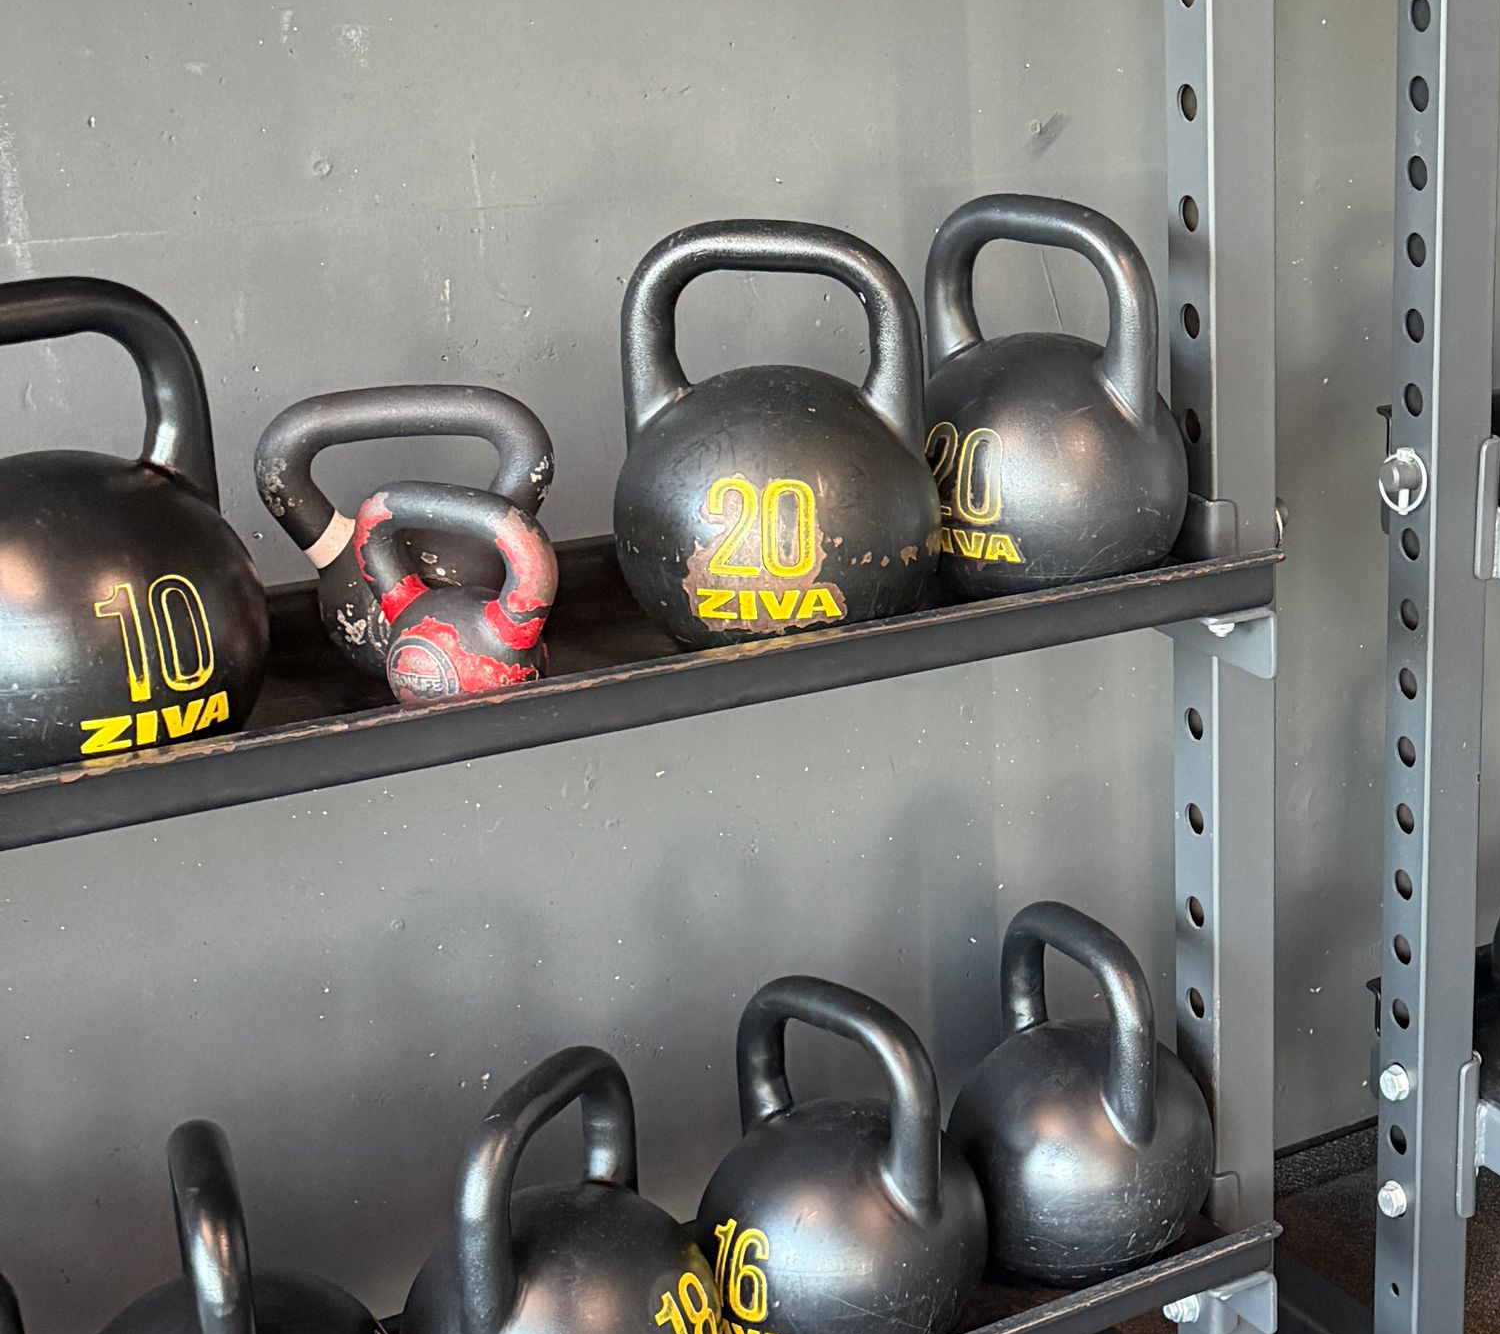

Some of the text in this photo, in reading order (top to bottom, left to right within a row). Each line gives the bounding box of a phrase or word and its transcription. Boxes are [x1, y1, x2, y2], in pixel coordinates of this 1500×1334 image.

[708, 478, 816, 578] 20
[941, 526, 1022, 563] IVA
[94, 574, 214, 703] 10
[696, 587, 843, 621] ZIVA
[80, 691, 230, 755] ZIVA
[714, 1218, 770, 1323] 16
